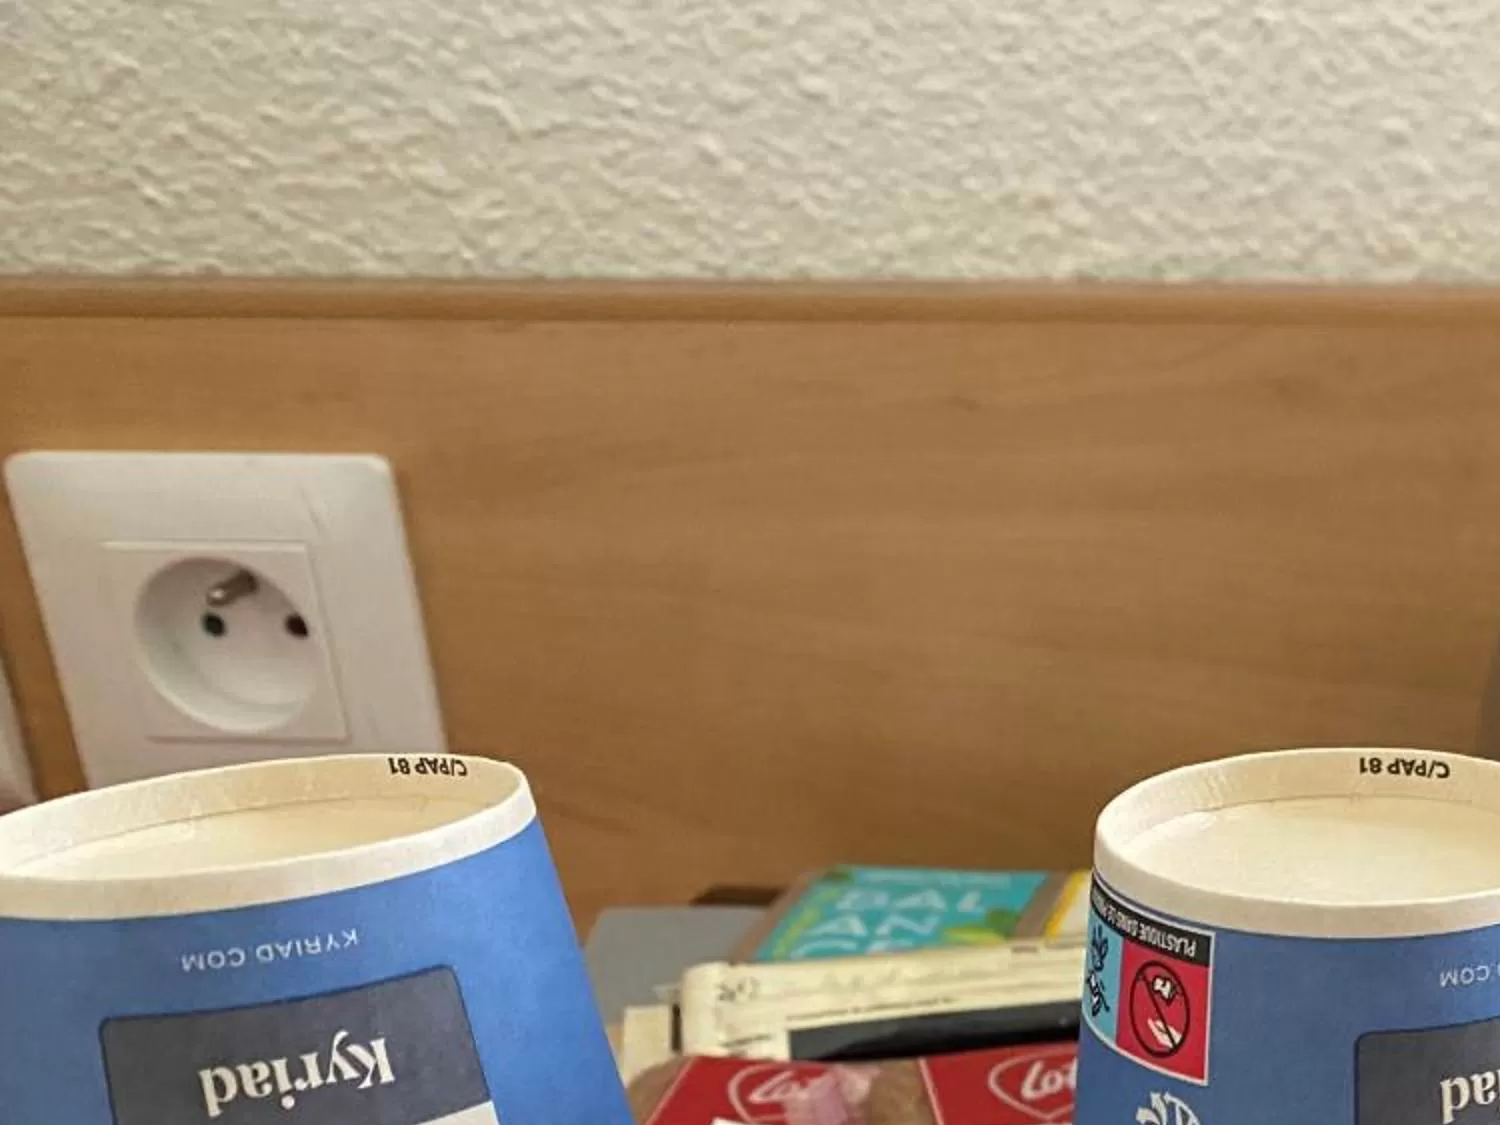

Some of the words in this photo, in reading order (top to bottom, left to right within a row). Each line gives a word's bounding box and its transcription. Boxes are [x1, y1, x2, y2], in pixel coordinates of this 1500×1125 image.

[387, 757, 411, 775] 81
[414, 757, 468, 777] C/PAP
[1359, 757, 1383, 775] 81
[1386, 758, 1451, 779] C/PAP
[1138, 922, 1198, 957] PLASTIQUE
[198, 1029, 396, 1119] Kyriad
